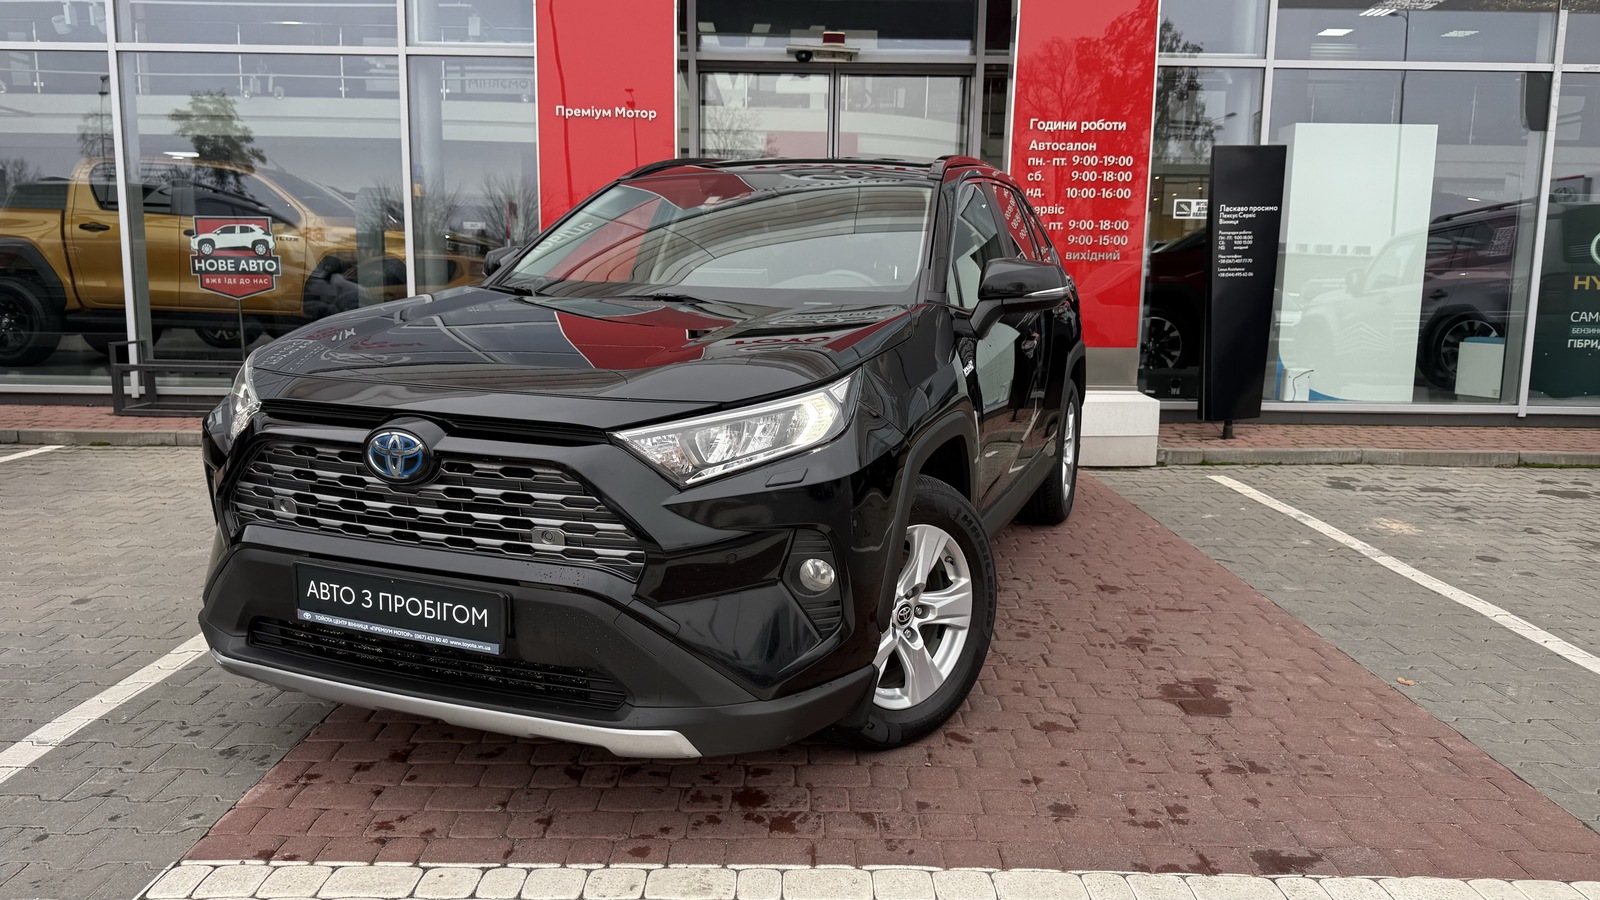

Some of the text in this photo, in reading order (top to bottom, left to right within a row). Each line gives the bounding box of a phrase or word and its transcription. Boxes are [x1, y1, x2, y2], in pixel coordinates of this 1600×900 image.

[555, 105, 657, 121] Преміум Мотор
[1029, 118, 1127, 133] Години роботи
[1029, 140, 1097, 151] Автосалон
[1072, 155, 1133, 167] 9:00-19:00
[1027, 170, 1132, 182] сб. 9:00-18:00
[1026, 187, 1131, 199] нд. 10:00-16:00
[1034, 203, 1065, 216] ервіс
[1220, 204, 1248, 212] Ласкаво
[1068, 220, 1129, 231] 9:00-18:00
[1067, 235, 1128, 246] 9:00-15:00
[1065, 250, 1120, 261] вихідний
[194, 259, 277, 272] НОВЕ АВТО
[224, 277, 237, 285] ЇДЕ
[1570, 311, 1600, 323] САМ
[306, 580, 488, 628] АВТО З ПРОБІГОМ
[315, 614, 333, 623] ТОЙОТА
[333, 617, 347, 626] ЦЕНТР
[348, 620, 369, 630] ВІННИЦЯ
[414, 632, 427, 641] (067)
